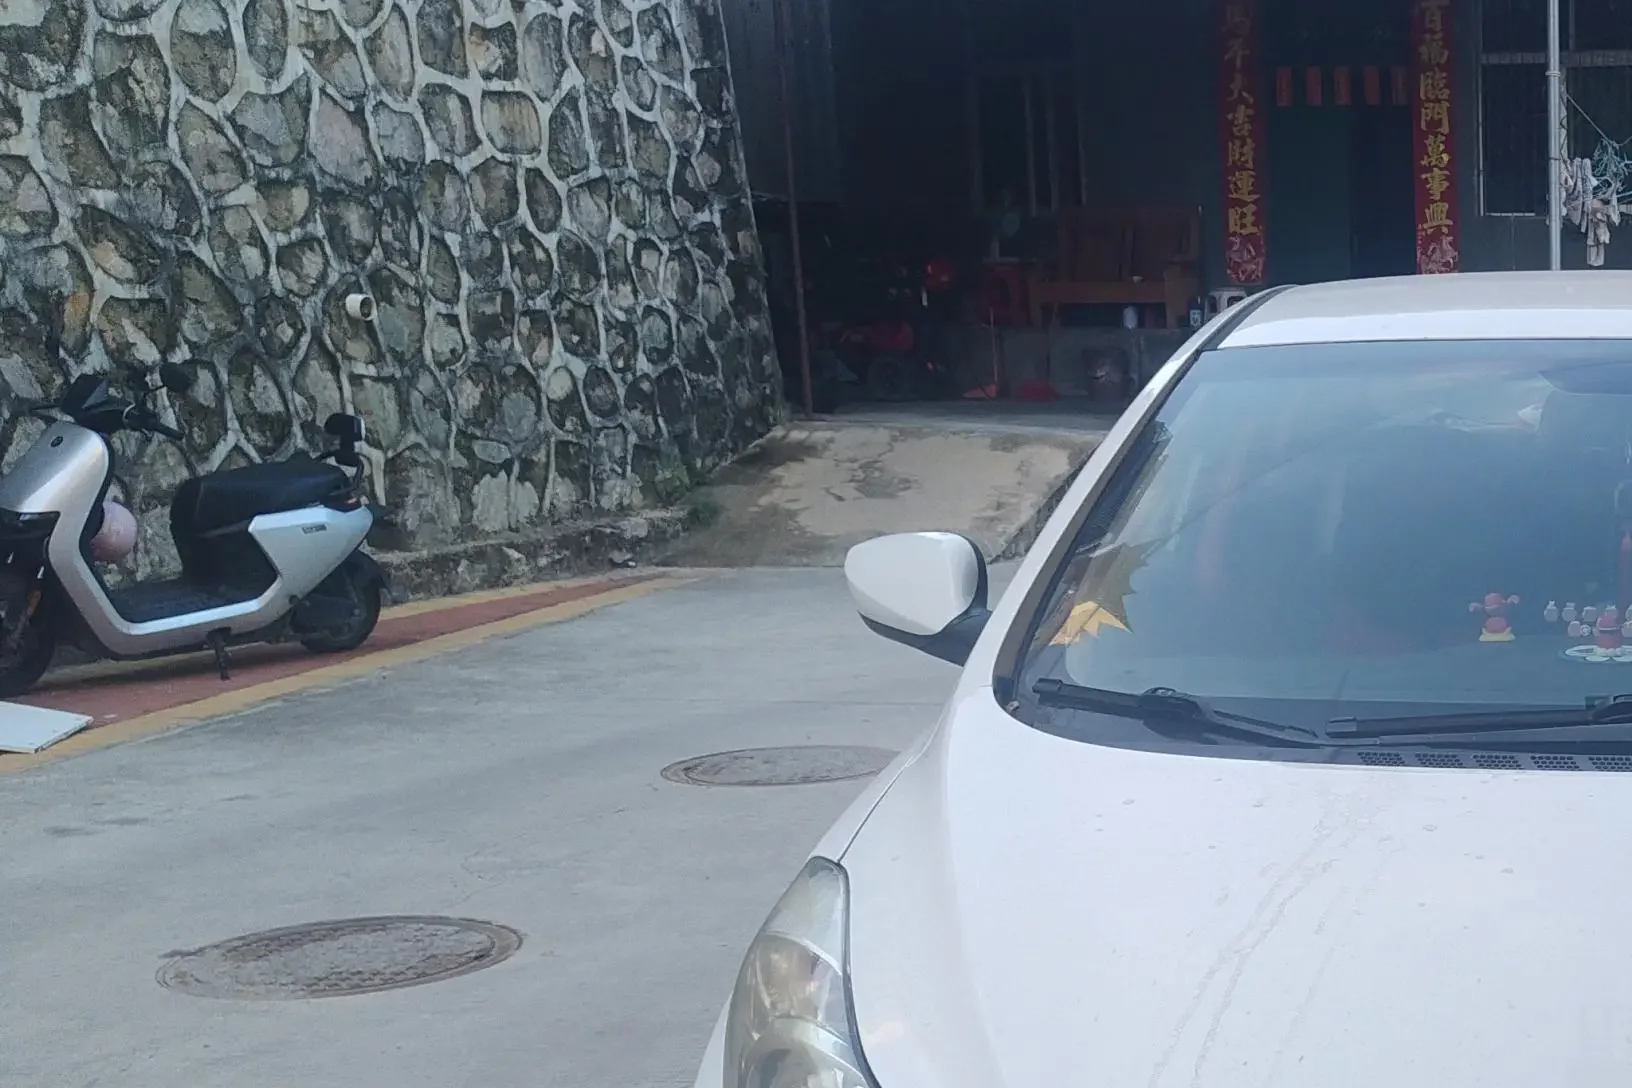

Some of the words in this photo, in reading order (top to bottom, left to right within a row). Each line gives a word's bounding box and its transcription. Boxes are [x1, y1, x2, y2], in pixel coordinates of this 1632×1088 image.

[1418, 1, 1454, 235] 百福臨門萬事興
